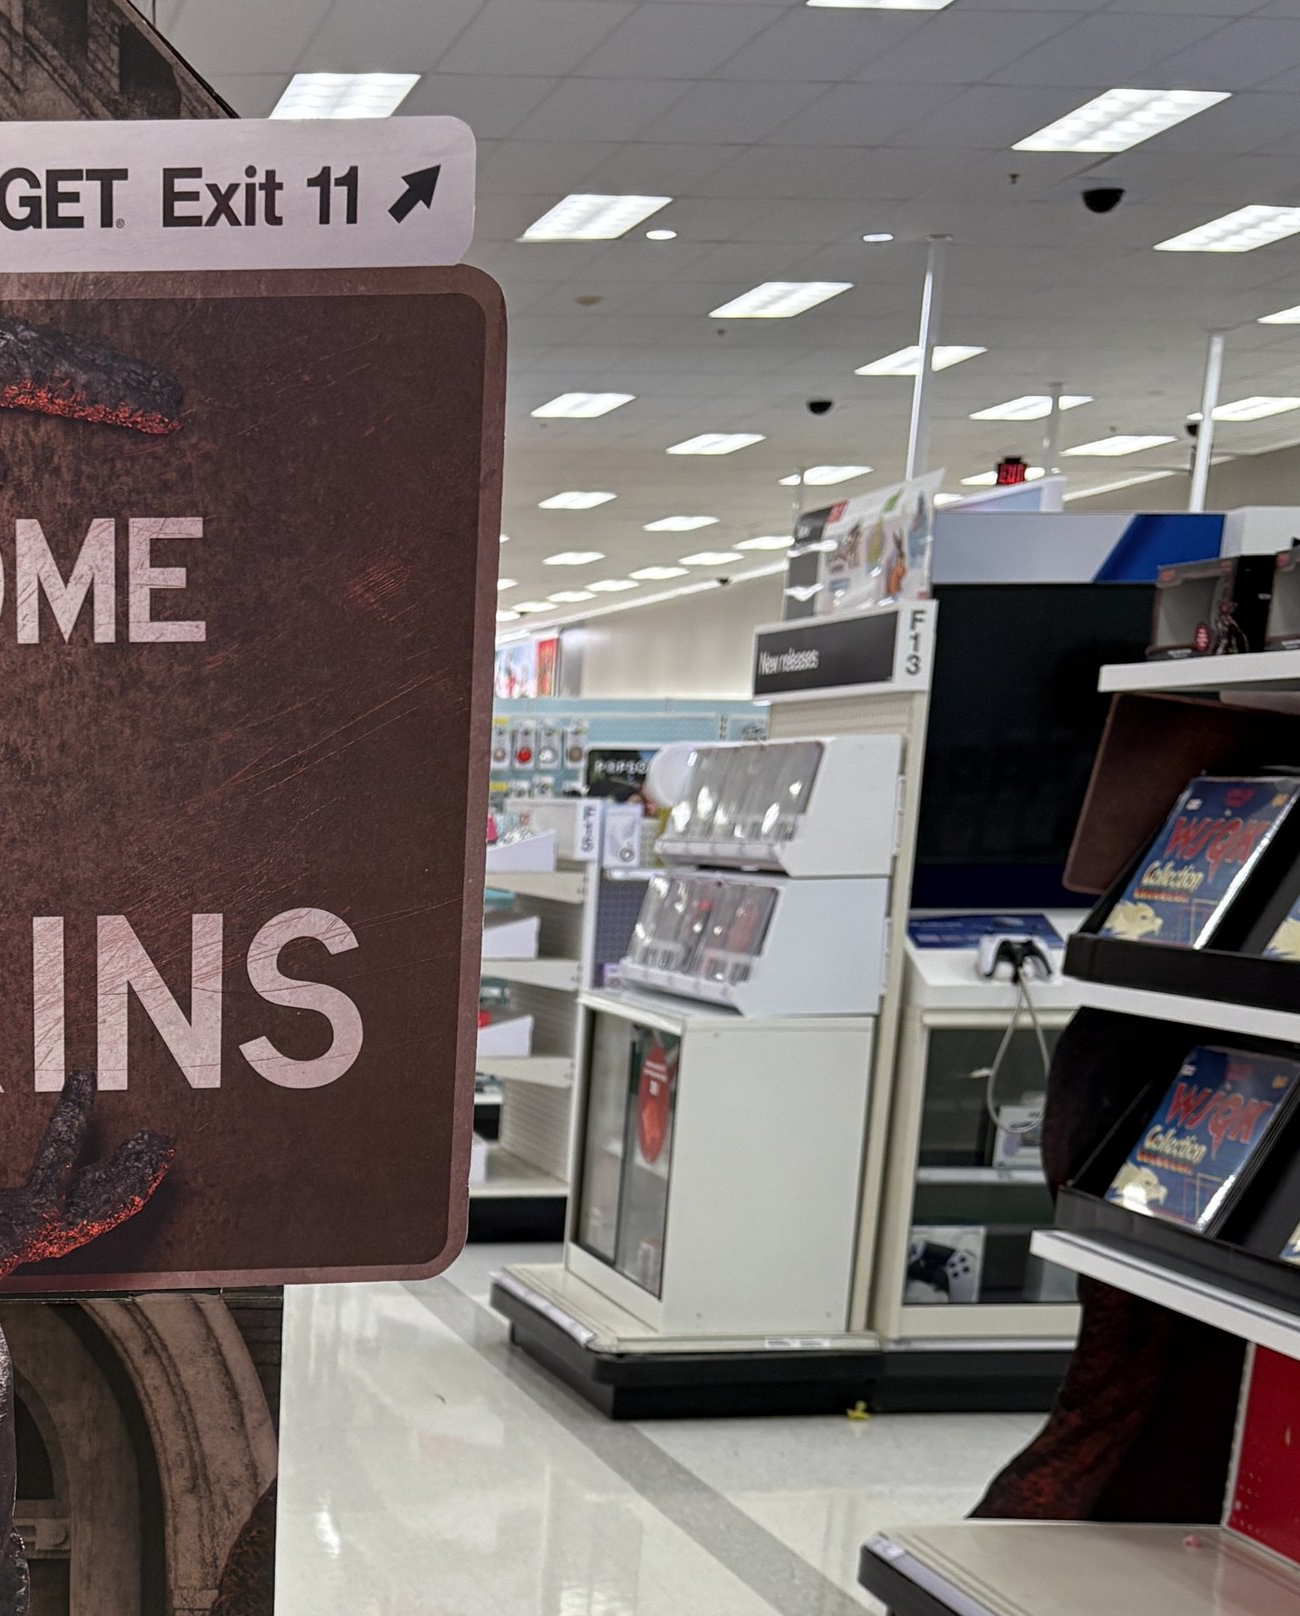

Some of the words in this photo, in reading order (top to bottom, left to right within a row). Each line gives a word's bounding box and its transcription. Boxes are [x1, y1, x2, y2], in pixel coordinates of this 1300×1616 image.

[162, 164, 285, 228] Exit
[306, 164, 359, 226] 11
[758, 651, 779, 675] New
[780, 647, 821, 673] releases
[905, 609, 927, 677] F13
[1140, 858, 1205, 891] Collection
[1143, 1123, 1208, 1164] Collection
